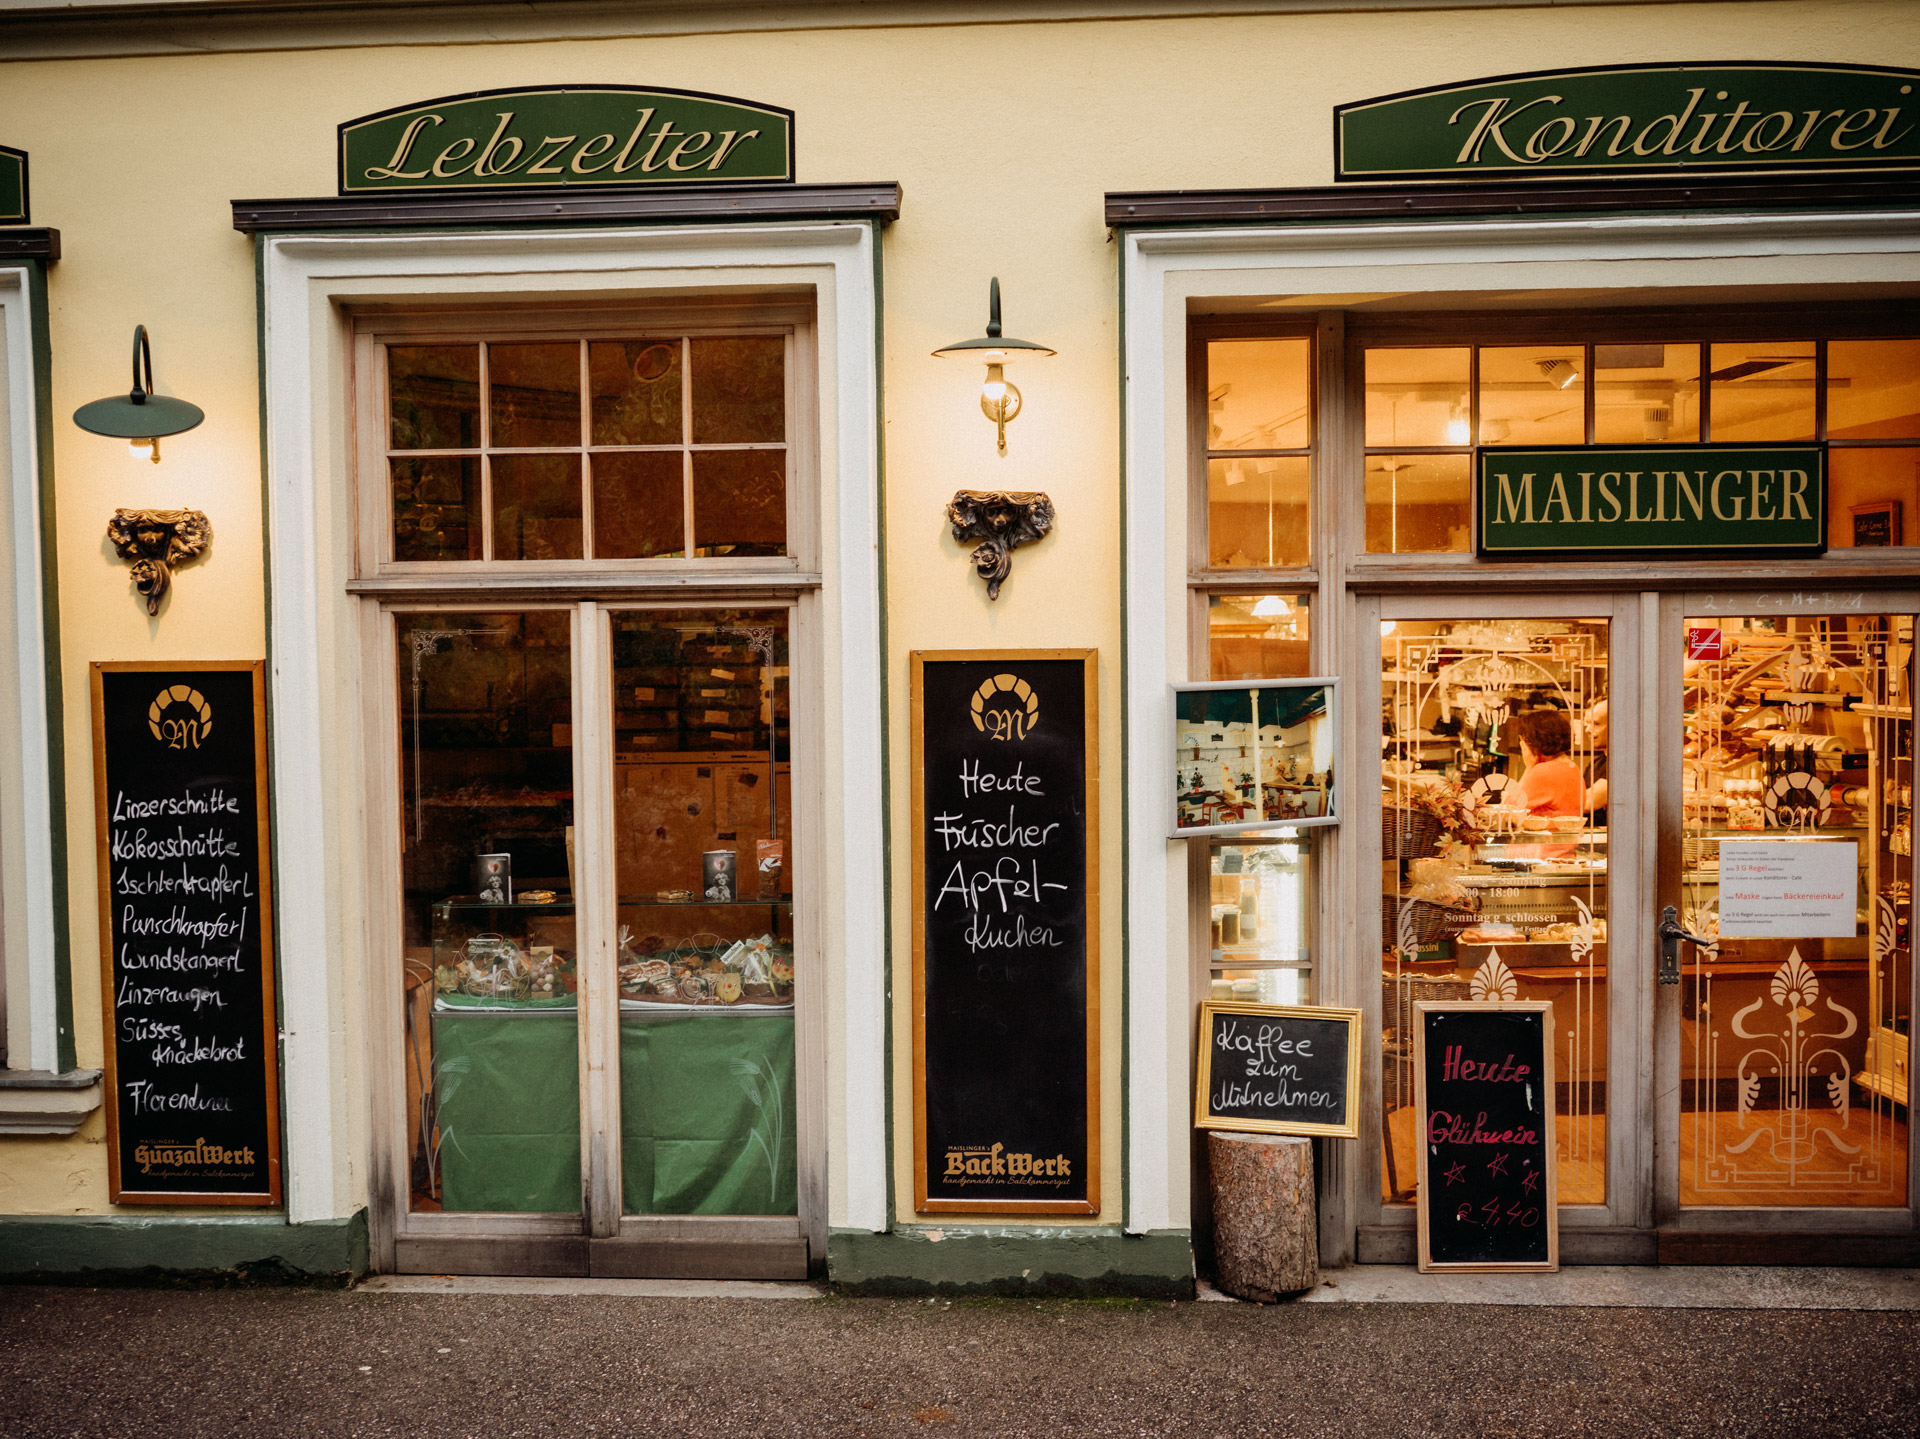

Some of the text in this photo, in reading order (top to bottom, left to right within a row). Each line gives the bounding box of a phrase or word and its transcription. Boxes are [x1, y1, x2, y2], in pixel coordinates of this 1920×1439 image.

[1447, 84, 1915, 165] Konditorei
[364, 107, 760, 181] Lebzelter
[1490, 469, 1814, 525] MAISLINGER
[1791, 592, 1804, 606] M
[959, 758, 1046, 799] Heute
[112, 788, 240, 822] Linzerschnitte
[933, 856, 1068, 913] Apfel-
[1741, 864, 1747, 872] G
[1748, 864, 1768, 873] Regel
[1489, 887, 1520, 898] 18:00
[1735, 892, 1760, 900] Maske
[1783, 892, 1844, 900] Bäckereieinkauf
[122, 904, 247, 949] Punschkrapferl
[964, 913, 1064, 954] Kuchen
[1444, 912, 1491, 924] Sonntag
[117, 975, 228, 1012] Linzeraugen
[121, 1017, 183, 1043] Süsses
[1216, 1020, 1314, 1063] Kaffee
[1442, 1044, 1531, 1083] Heute
[1212, 1078, 1338, 1111] Mitnehmen
[1427, 1110, 1539, 1145] Glühwein
[942, 1175, 995, 1188] handgemacht
[1007, 1175, 1071, 1189] Salzkammergut
